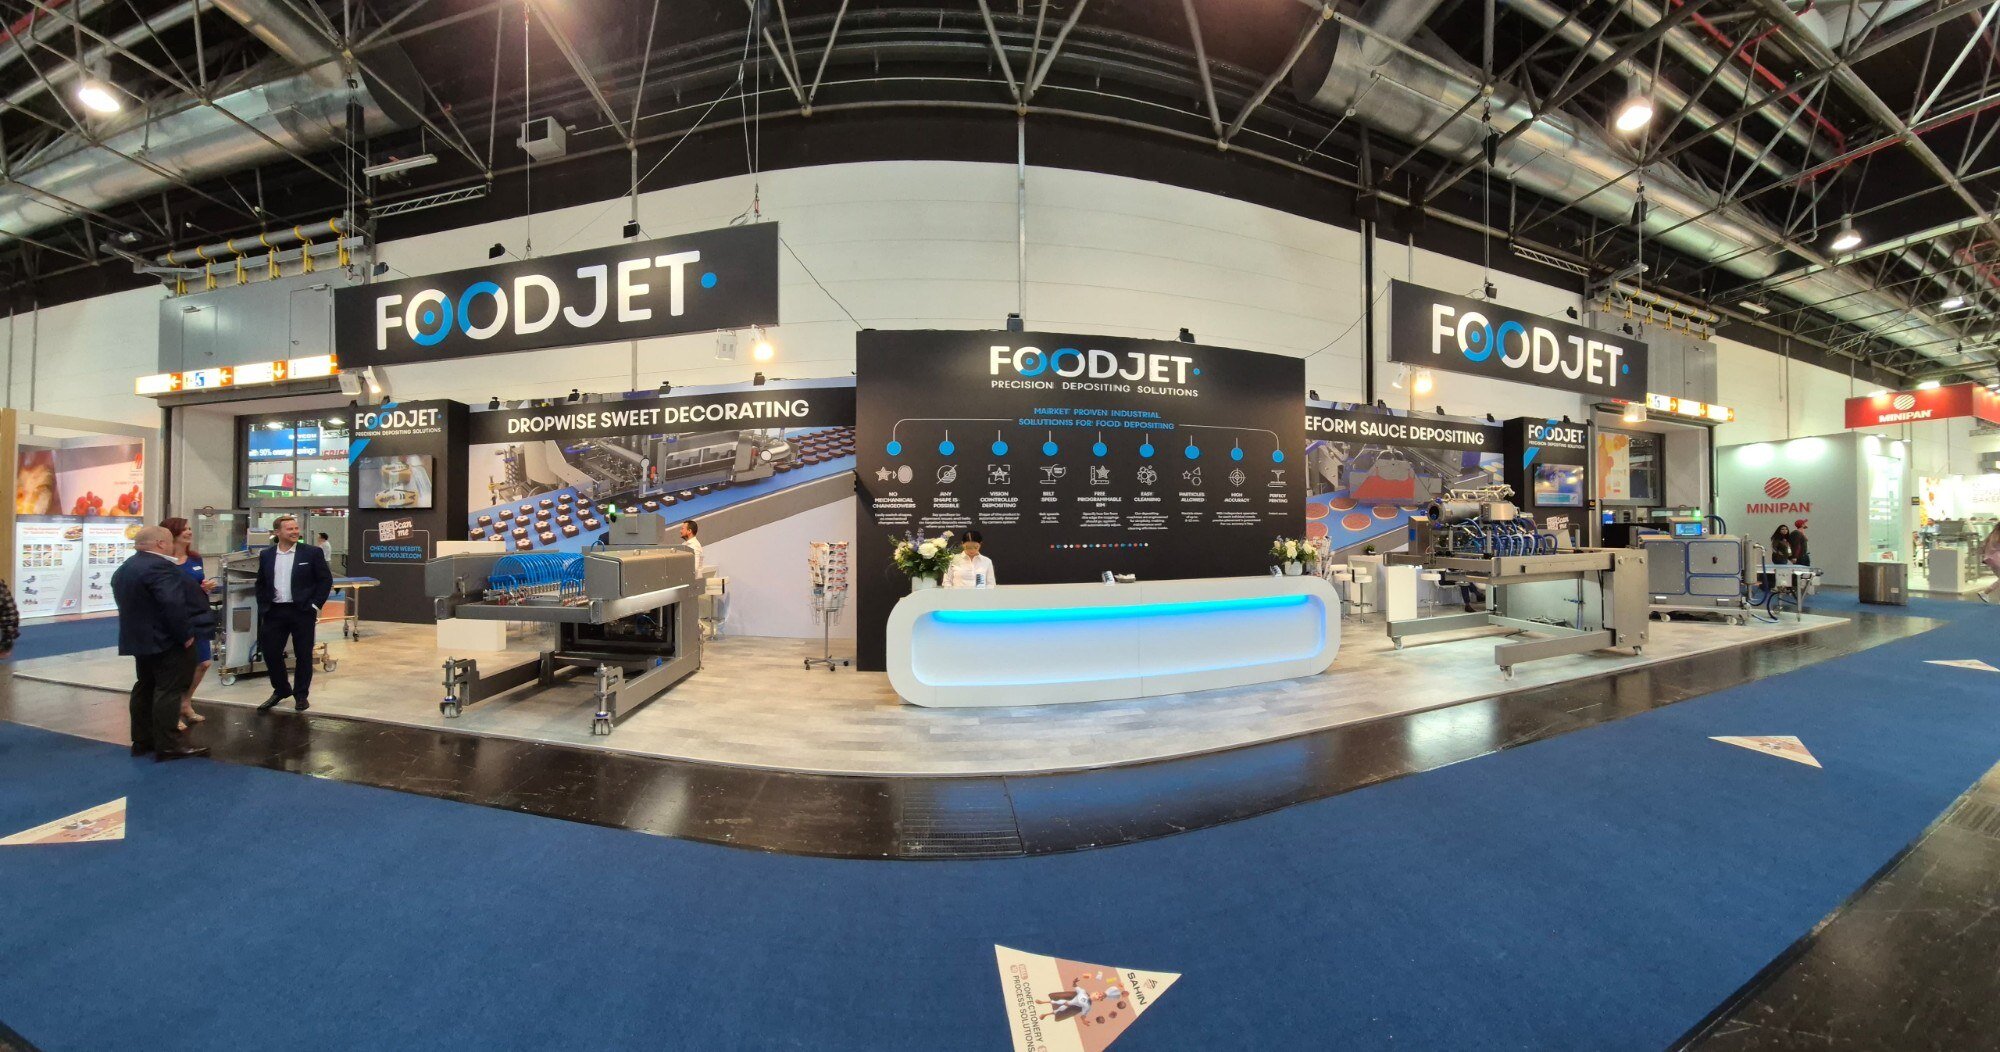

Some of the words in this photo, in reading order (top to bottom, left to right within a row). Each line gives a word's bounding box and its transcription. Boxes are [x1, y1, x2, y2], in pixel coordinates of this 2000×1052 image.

[376, 250, 700, 350] FOODJET
[1432, 303, 1624, 387] FOODJET
[989, 345, 1193, 384] FOODJET
[991, 380, 1054, 390] PRECISION
[1062, 381, 1131, 393] DEPOSITING
[1137, 385, 1199, 397] SOLUTIONS
[355, 408, 439, 430] FOODJET
[507, 412, 597, 434] DROPWISE
[600, 408, 661, 428] SWEET
[664, 399, 810, 425] DECORATING
[1018, 418, 1074, 427] SOLUTIONS
[1075, 419, 1094, 427] FOR
[1096, 419, 1121, 428] FOOD
[1124, 421, 1175, 430] DEPOSITING
[1073, 408, 1108, 417] PROVEN
[1111, 409, 1162, 419] INDUSTRIAL
[1878, 409, 1933, 423] MINIPAN
[1360, 421, 1407, 439] SAUCE
[1409, 427, 1485, 445] DEPOSITING
[1528, 424, 1584, 444] FOODJET
[1746, 502, 1811, 514] MINIPAN
[394, 520, 413, 531] Scan
[397, 529, 409, 537] me
[1012, 975, 1026, 1008] PROCESS
[1019, 1007, 1036, 1052] SOLUTIONS
[1022, 982, 1044, 1043] CONFECTIONERY
